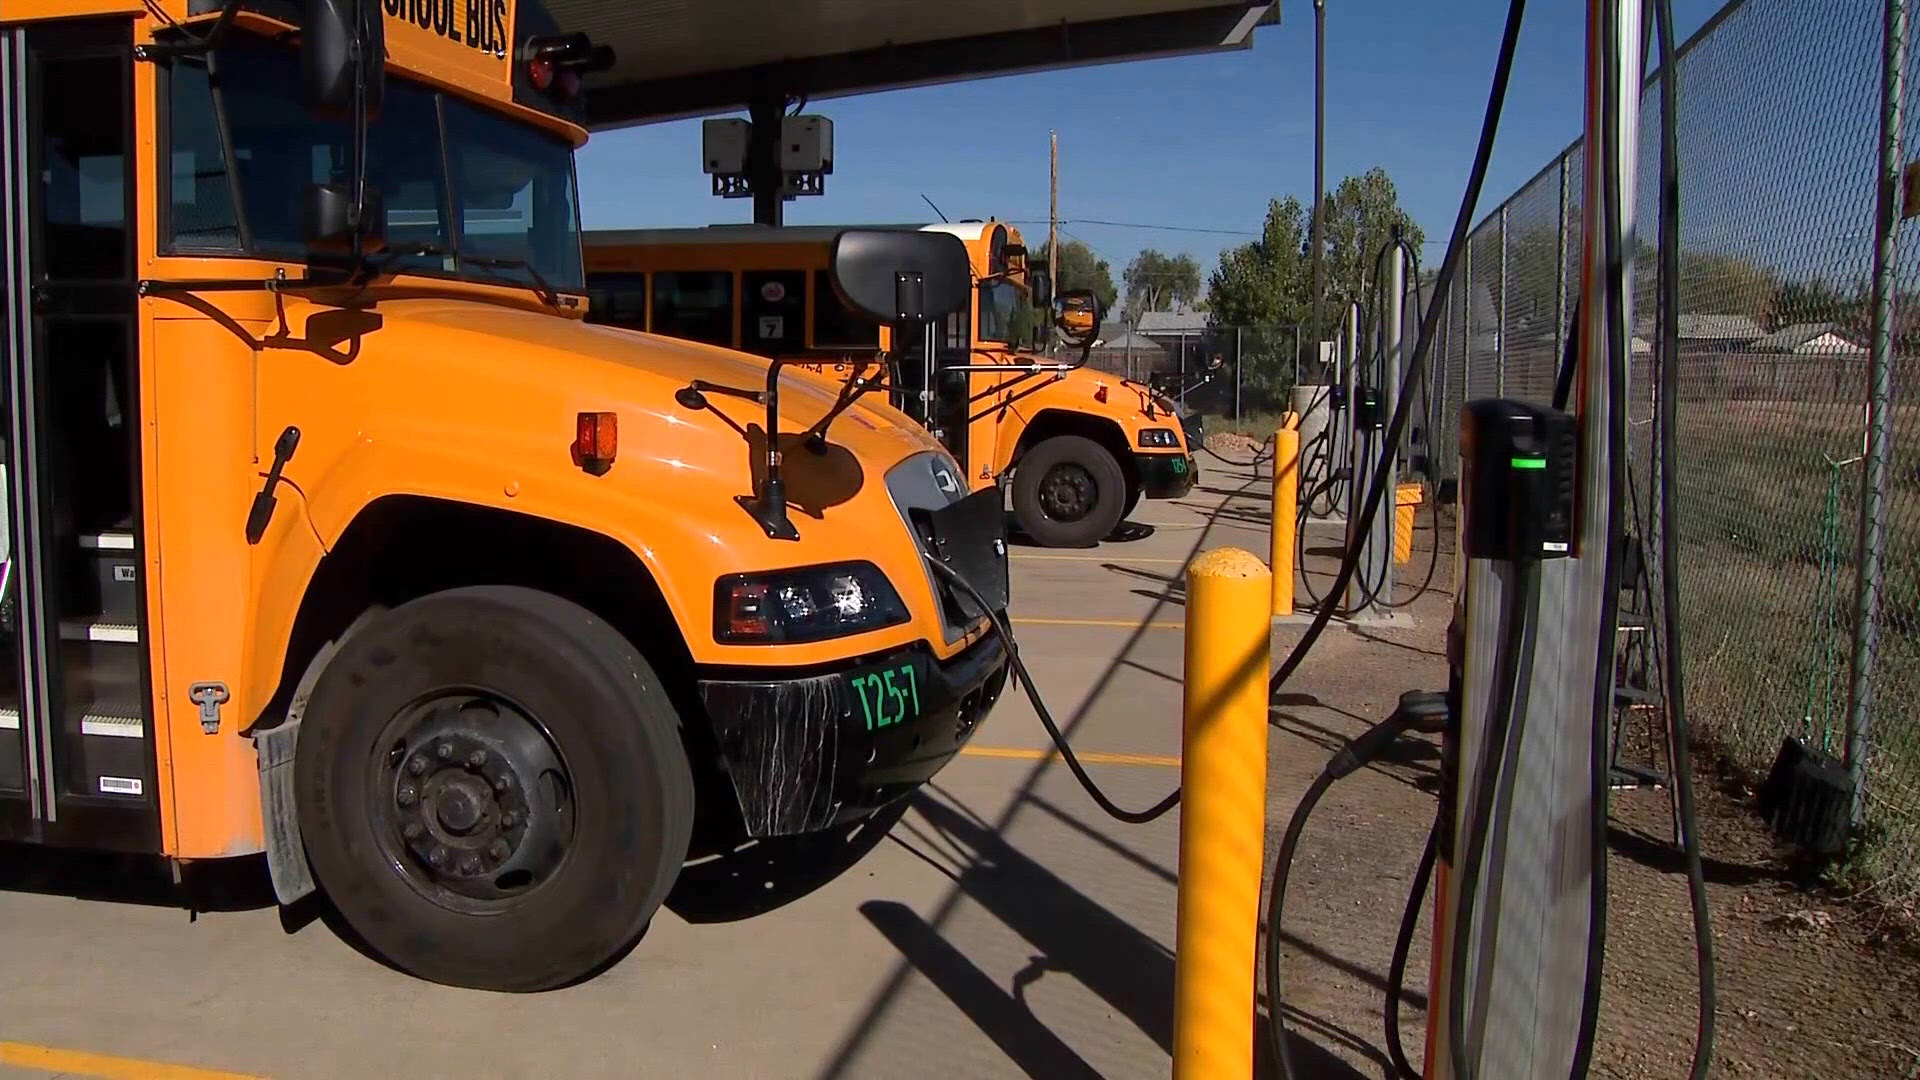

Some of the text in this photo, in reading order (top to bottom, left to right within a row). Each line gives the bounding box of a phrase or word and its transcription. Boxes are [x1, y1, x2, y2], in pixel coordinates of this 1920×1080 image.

[466, 0, 507, 60] BUS
[766, 324, 776, 336] 7
[852, 665, 919, 731] T25-7
